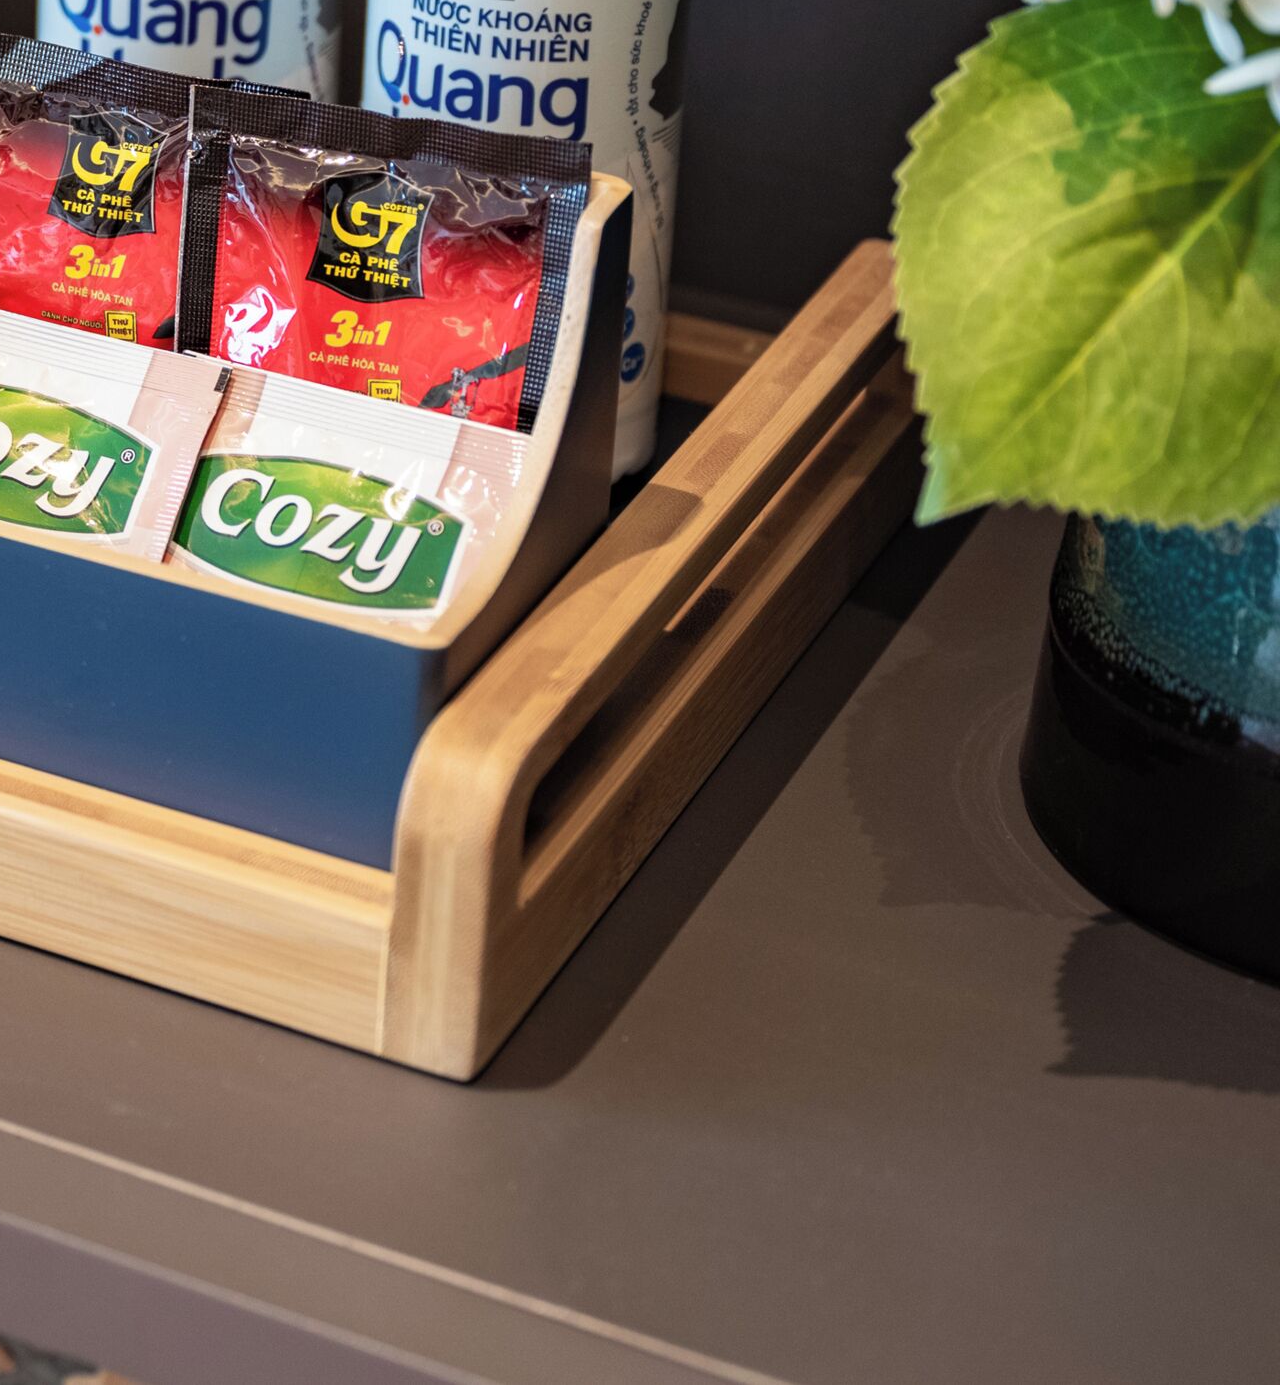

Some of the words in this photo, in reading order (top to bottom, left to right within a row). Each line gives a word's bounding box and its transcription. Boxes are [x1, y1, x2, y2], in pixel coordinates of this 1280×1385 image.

[478, 8, 592, 33] KHOÁNG
[412, 16, 481, 55] THIÊN
[492, 34, 589, 63] NHIÊN
[377, 19, 589, 141] Quang
[72, 141, 150, 191] G7
[122, 142, 153, 153] COFFEE
[62, 199, 94, 215] THỨ
[97, 206, 144, 223] THIỆT
[77, 188, 95, 202] CÀ
[101, 194, 132, 208] PHÊ
[331, 200, 417, 255] G7
[383, 202, 418, 214] COFFEE
[65, 244, 127, 279] 3in1
[324, 264, 360, 279] THỨ
[363, 270, 410, 289] THIỆT
[339, 251, 361, 265] CÀ
[367, 256, 399, 272] PHÊ
[51, 282, 66, 294] CÀ
[67, 284, 88, 298] PHÊ
[91, 288, 111, 302] HÒA
[113, 293, 133, 307] TAN
[325, 310, 392, 347] 3in1
[308, 351, 325, 363] CÀ
[327, 353, 349, 367] PHÊ
[352, 357, 375, 371] HÒA
[378, 362, 399, 375] TAN
[199, 468, 422, 594] Cozy
